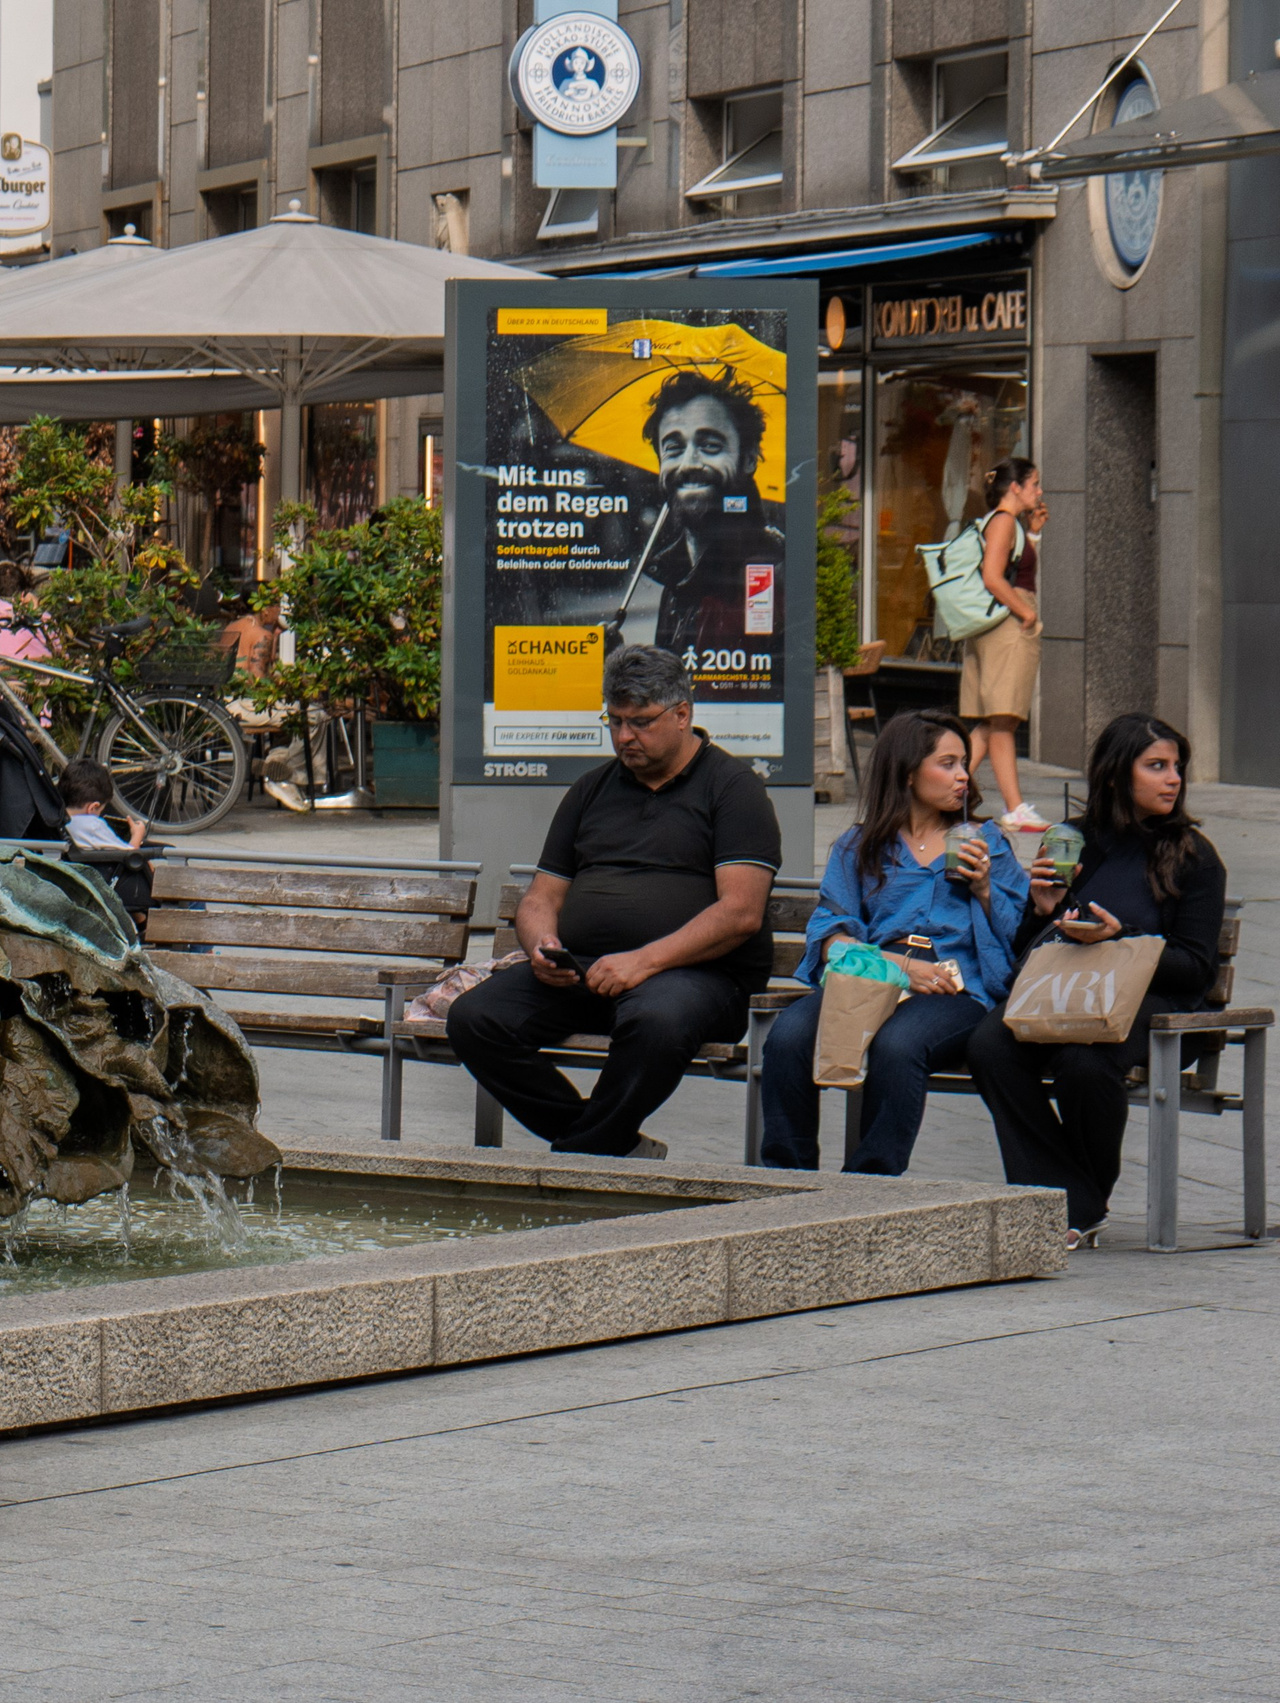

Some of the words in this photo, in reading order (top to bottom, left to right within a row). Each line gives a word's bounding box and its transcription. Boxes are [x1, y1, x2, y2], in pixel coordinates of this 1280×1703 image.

[535, 90, 585, 123] FRIEDRICH
[543, 86, 614, 112] HANNOVER
[506, 317, 524, 325] ÜBER
[551, 318, 599, 326] DEUTSCHLAND
[498, 464, 537, 486] Mit
[543, 468, 586, 486] uns
[497, 490, 549, 513] dem
[555, 491, 629, 517] Regen
[496, 518, 585, 538] trotzen
[496, 544, 569, 557] Sofortbargeld
[570, 544, 600, 555] durch
[496, 559, 541, 570] Beleihen
[543, 559, 566, 570] oder
[568, 558, 630, 570] Goldverkauf
[701, 649, 747, 671] 200
[750, 653, 772, 671] m
[507, 667, 558, 675] GOLDANKAUF
[500, 732, 514, 740] IHR
[515, 732, 550, 740] EXPERTE
[551, 731, 568, 740] FÜR
[569, 732, 598, 740] WERTE.
[1004, 968, 1116, 1017] ZARA
